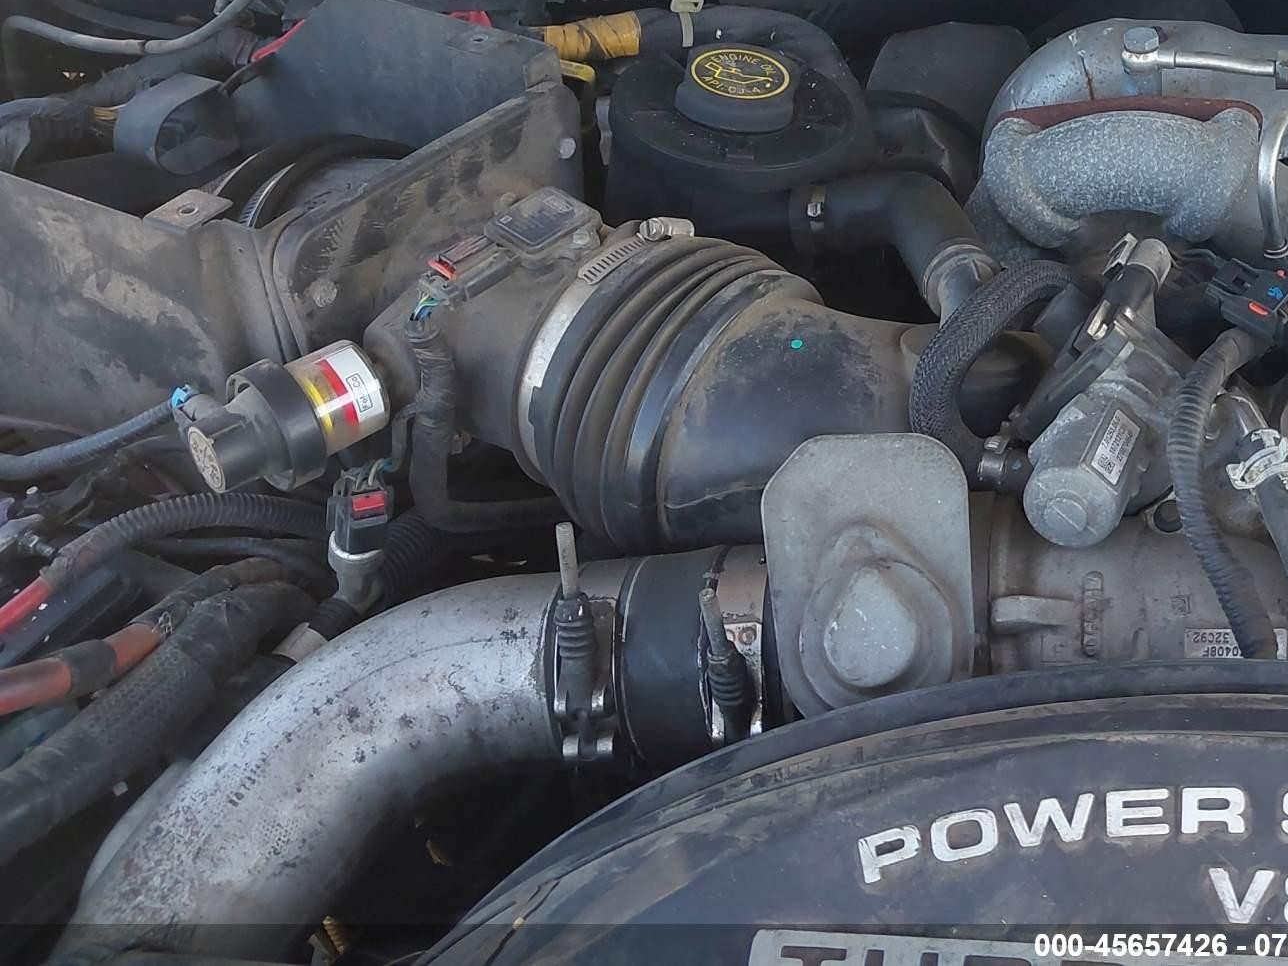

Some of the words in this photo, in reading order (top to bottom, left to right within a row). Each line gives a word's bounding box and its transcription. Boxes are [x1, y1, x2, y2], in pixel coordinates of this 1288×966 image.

[710, 54, 760, 65] ENGINE
[760, 64, 777, 76] OIL
[1193, 632, 1229, 643] 32C92
[858, 787, 1247, 885] POWER
